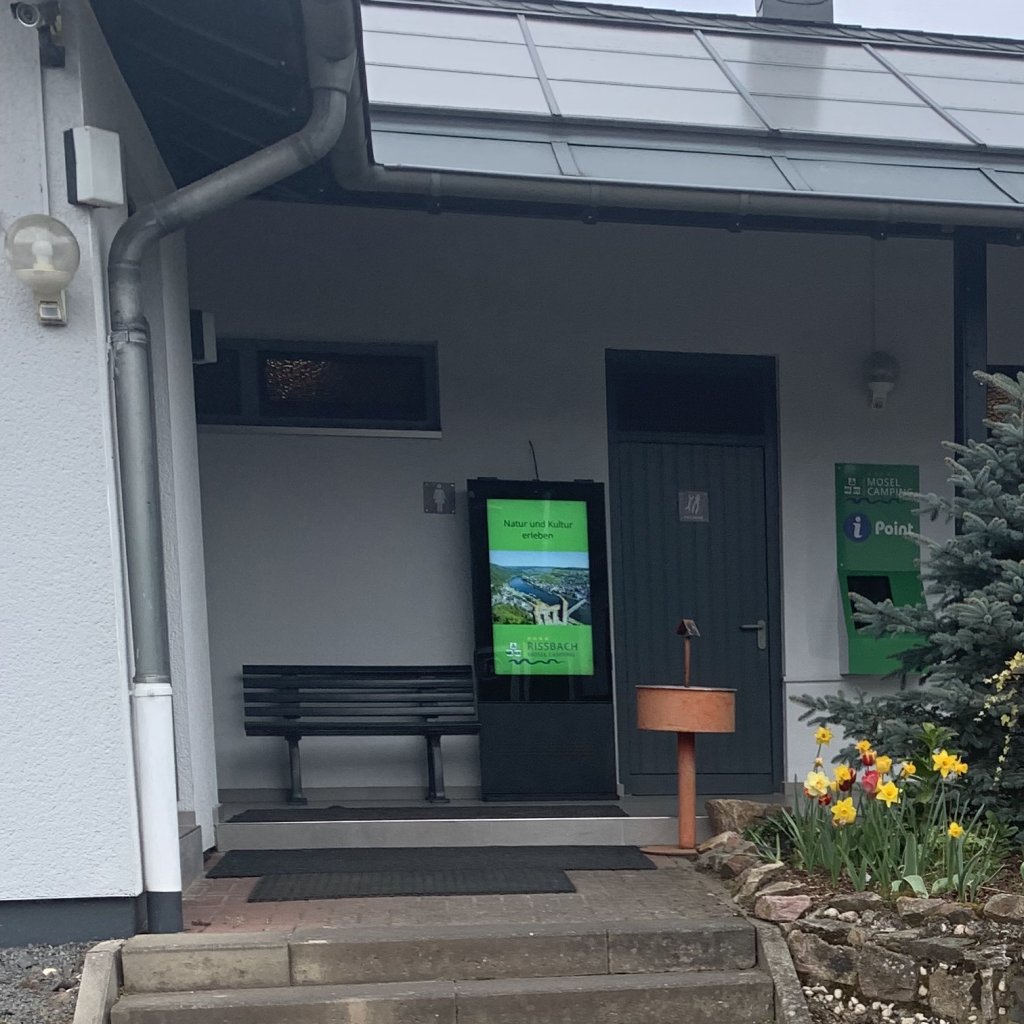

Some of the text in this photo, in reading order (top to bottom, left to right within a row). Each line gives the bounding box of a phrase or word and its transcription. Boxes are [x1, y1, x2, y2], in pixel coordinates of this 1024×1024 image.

[867, 478, 900, 487] MOSEL
[503, 520, 527, 528] Natur
[529, 520, 546, 528] und
[875, 521, 914, 536] Point
[521, 532, 554, 540] erleben
[527, 642, 578, 651] RISSBACH
